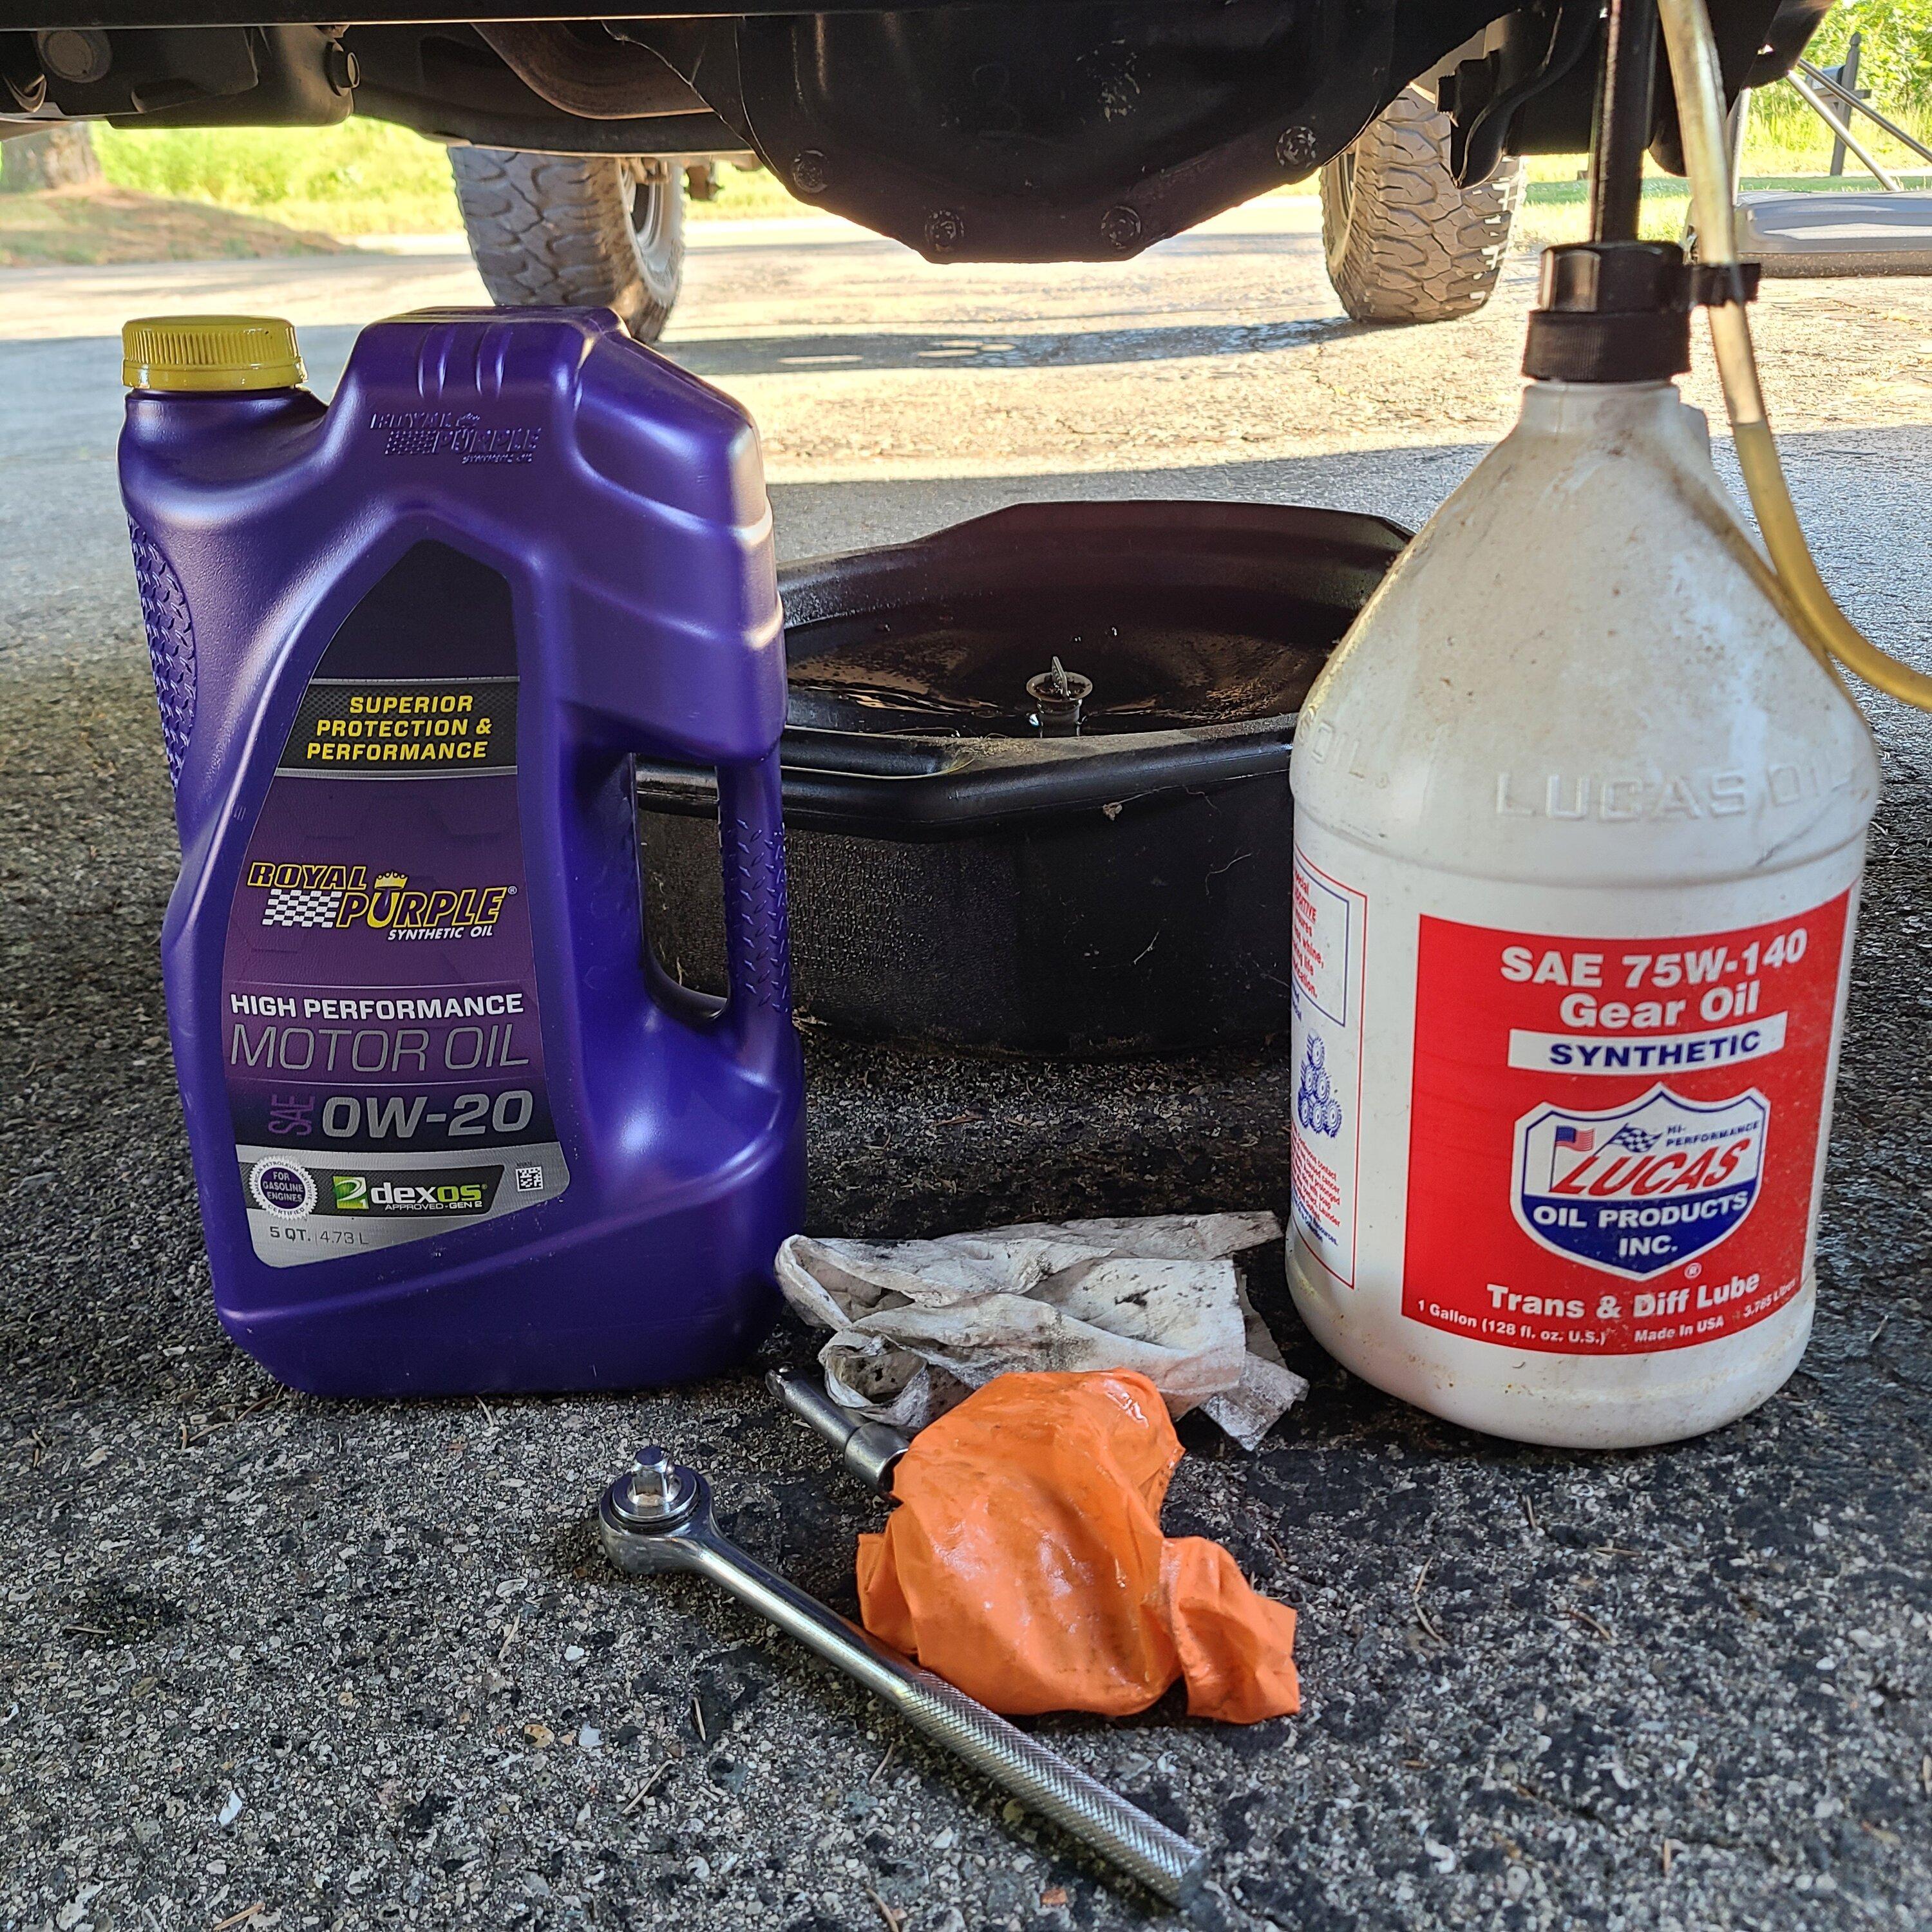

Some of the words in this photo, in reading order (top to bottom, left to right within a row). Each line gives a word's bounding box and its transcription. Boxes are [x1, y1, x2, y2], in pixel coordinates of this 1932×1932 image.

[350, 695, 473, 714] SUPERIOR
[316, 718, 468, 737] PROTECTION
[476, 718, 492, 735] &
[307, 741, 488, 761] PERFORMANCE
[1496, 772, 1748, 822] LUCAS
[247, 862, 368, 890] ROYAL
[388, 926, 463, 941] SYNTHETIC
[470, 925, 493, 938] OIL
[1501, 945, 1605, 989] SAE
[1620, 927, 1807, 989] 75W-140
[229, 993, 297, 1019] HIGH
[304, 993, 524, 1020] PERFORMANCE
[1559, 994, 1685, 1029] Gear
[1700, 980, 1760, 1023] Oil
[229, 1023, 430, 1072] MOTOR
[444, 1023, 530, 1070] OIL
[1549, 1030, 1761, 1067] SYNTHETIC
[268, 1094, 316, 1135] SAE
[322, 1090, 534, 1139] 0W-20
[1665, 1119, 1761, 1148] PERFORMANCE
[272, 1171, 291, 1181] FOR
[1549, 1137, 1752, 1197] LUCAS
[262, 1180, 304, 1193] GASOLINE
[266, 1191, 303, 1202] ENGINES
[268, 1204, 305, 1216] CERTIFIED
[1533, 1206, 1587, 1229] OIL
[1598, 1190, 1749, 1229] PRODUCTS
[270, 1226, 279, 1239] 5
[285, 1227, 311, 1242] QT.
[319, 1230, 354, 1245] 4.73
[359, 1232, 370, 1245] L
[1618, 1234, 1678, 1258] INC.
[1486, 1283, 1586, 1319] Trans
[1596, 1294, 1622, 1319] &
[1633, 1288, 1690, 1318] Diff
[1696, 1273, 1760, 1310] Lube
[1743, 1293, 1773, 1318] 3.785
[1418, 1300, 1425, 1312] 1
[1429, 1303, 1478, 1329] Gallon
[1481, 1318, 1517, 1336] (128
[1520, 1325, 1537, 1340] fl.
[1540, 1330, 1564, 1342] oz.
[1568, 1329, 1607, 1347] U.S.)
[1634, 1327, 1676, 1343] Made
[1679, 1323, 1694, 1336] In
[1696, 1315, 1725, 1333] USA
